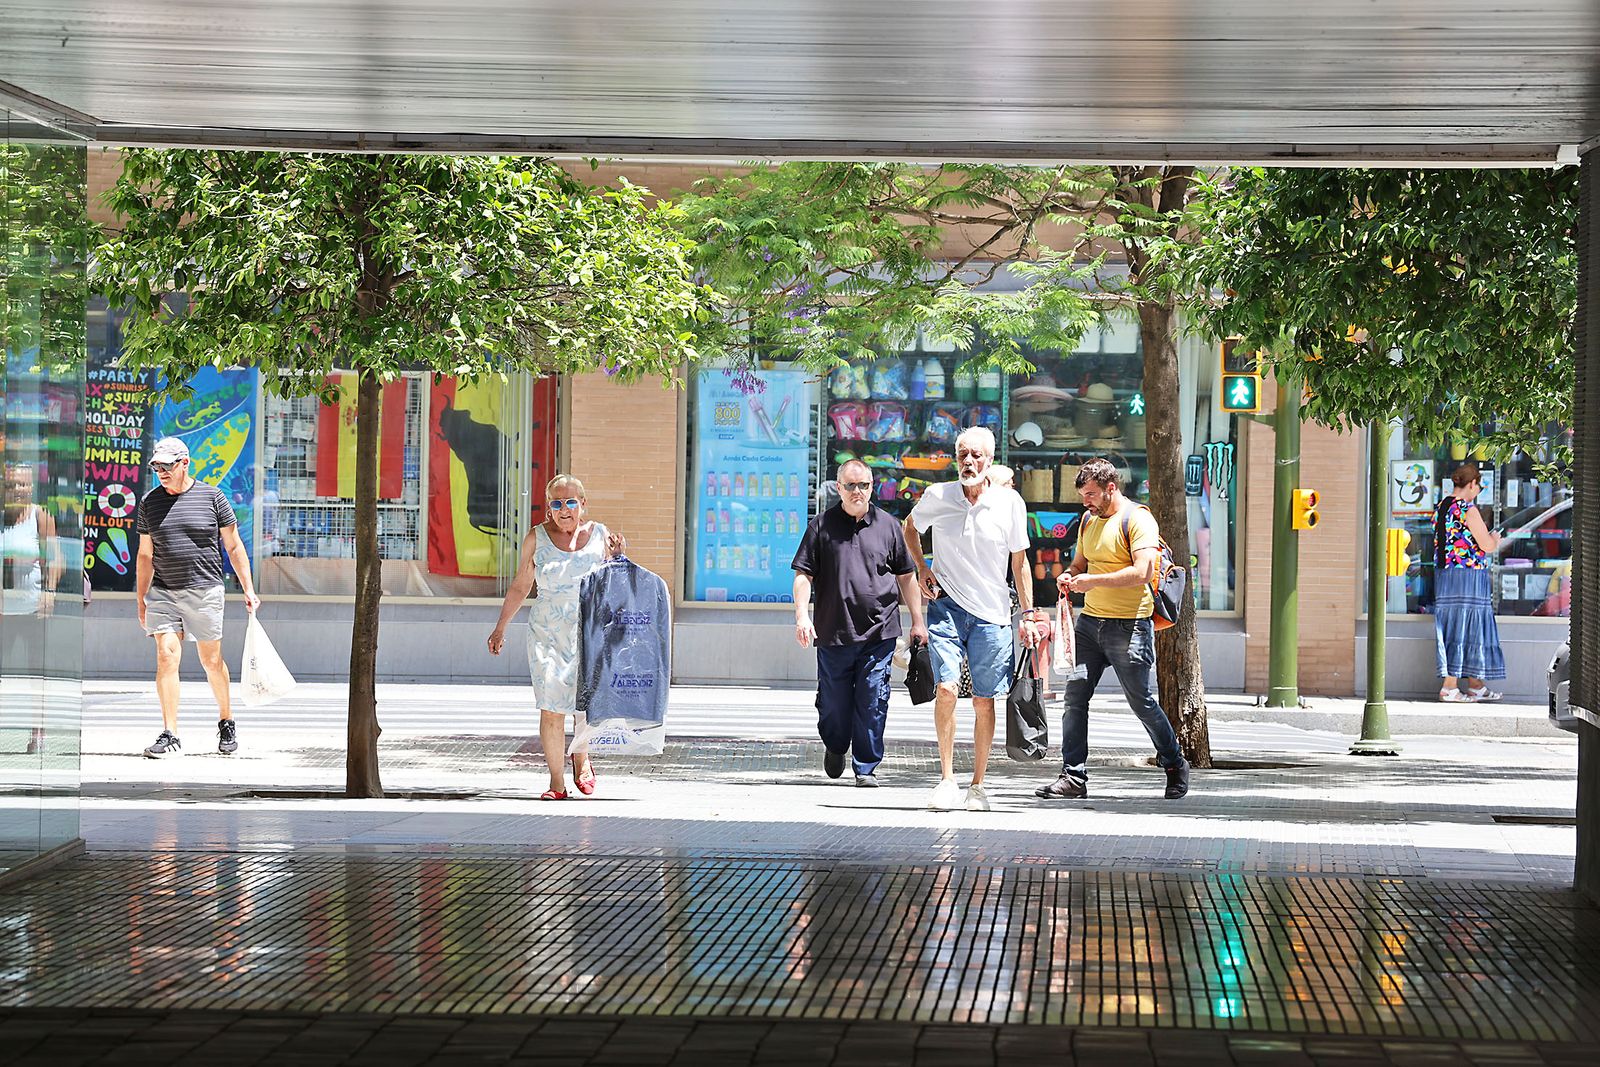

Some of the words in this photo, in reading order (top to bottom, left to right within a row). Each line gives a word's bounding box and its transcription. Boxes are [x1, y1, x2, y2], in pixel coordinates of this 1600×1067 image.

[88, 369, 149, 384] #PARTY
[86, 412, 145, 427] HOLIDAY
[715, 407, 740, 419] 800
